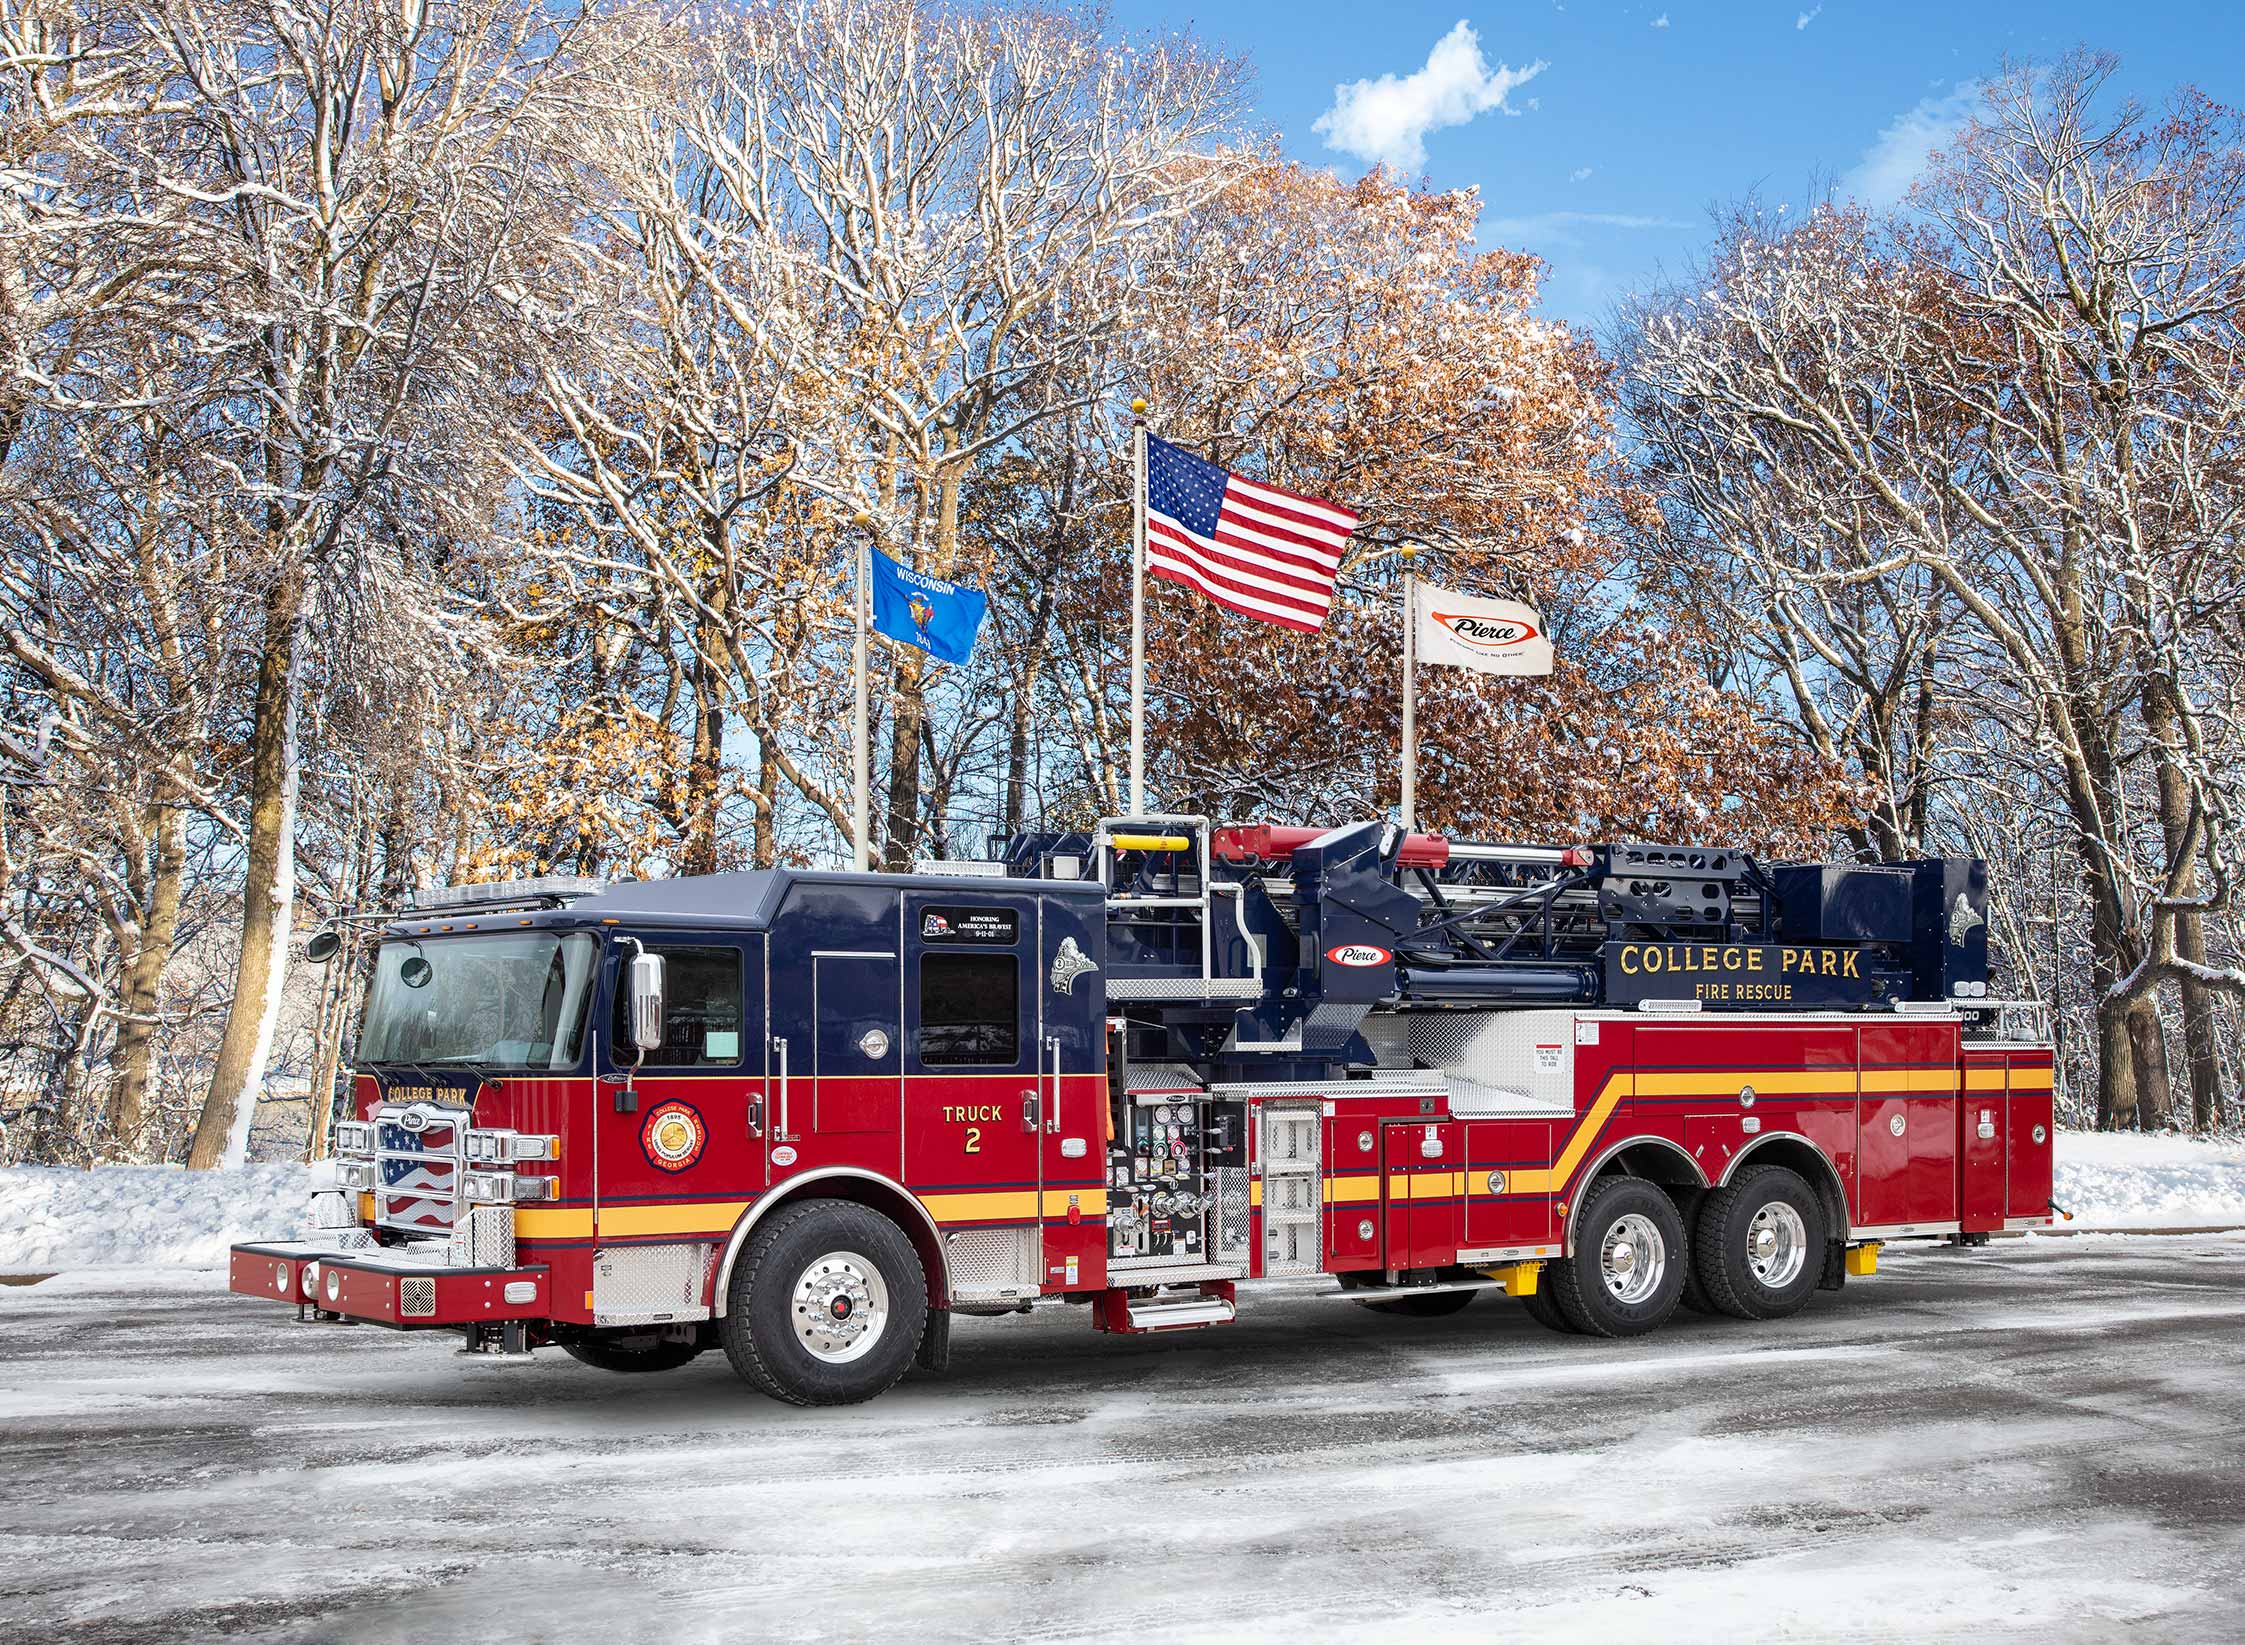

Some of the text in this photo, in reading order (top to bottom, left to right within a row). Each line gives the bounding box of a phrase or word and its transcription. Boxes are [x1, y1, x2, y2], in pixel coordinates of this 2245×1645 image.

[896, 566, 956, 596] WISCONSIN
[1454, 618, 1516, 640] Pierce
[1341, 947, 1377, 962] Pierce
[1620, 945, 1861, 979] COLLEGE PARK
[1695, 983, 1793, 1001] FIRE RESCUE
[387, 1086, 467, 1107] COLLEGE PARK
[403, 1114, 421, 1126] Pierce
[655, 1105, 691, 1117] COLLEGE PARK
[942, 1105, 1002, 1122] TRUCK
[964, 1127, 981, 1154] 2
[657, 1158, 691, 1168] GEORGIA
